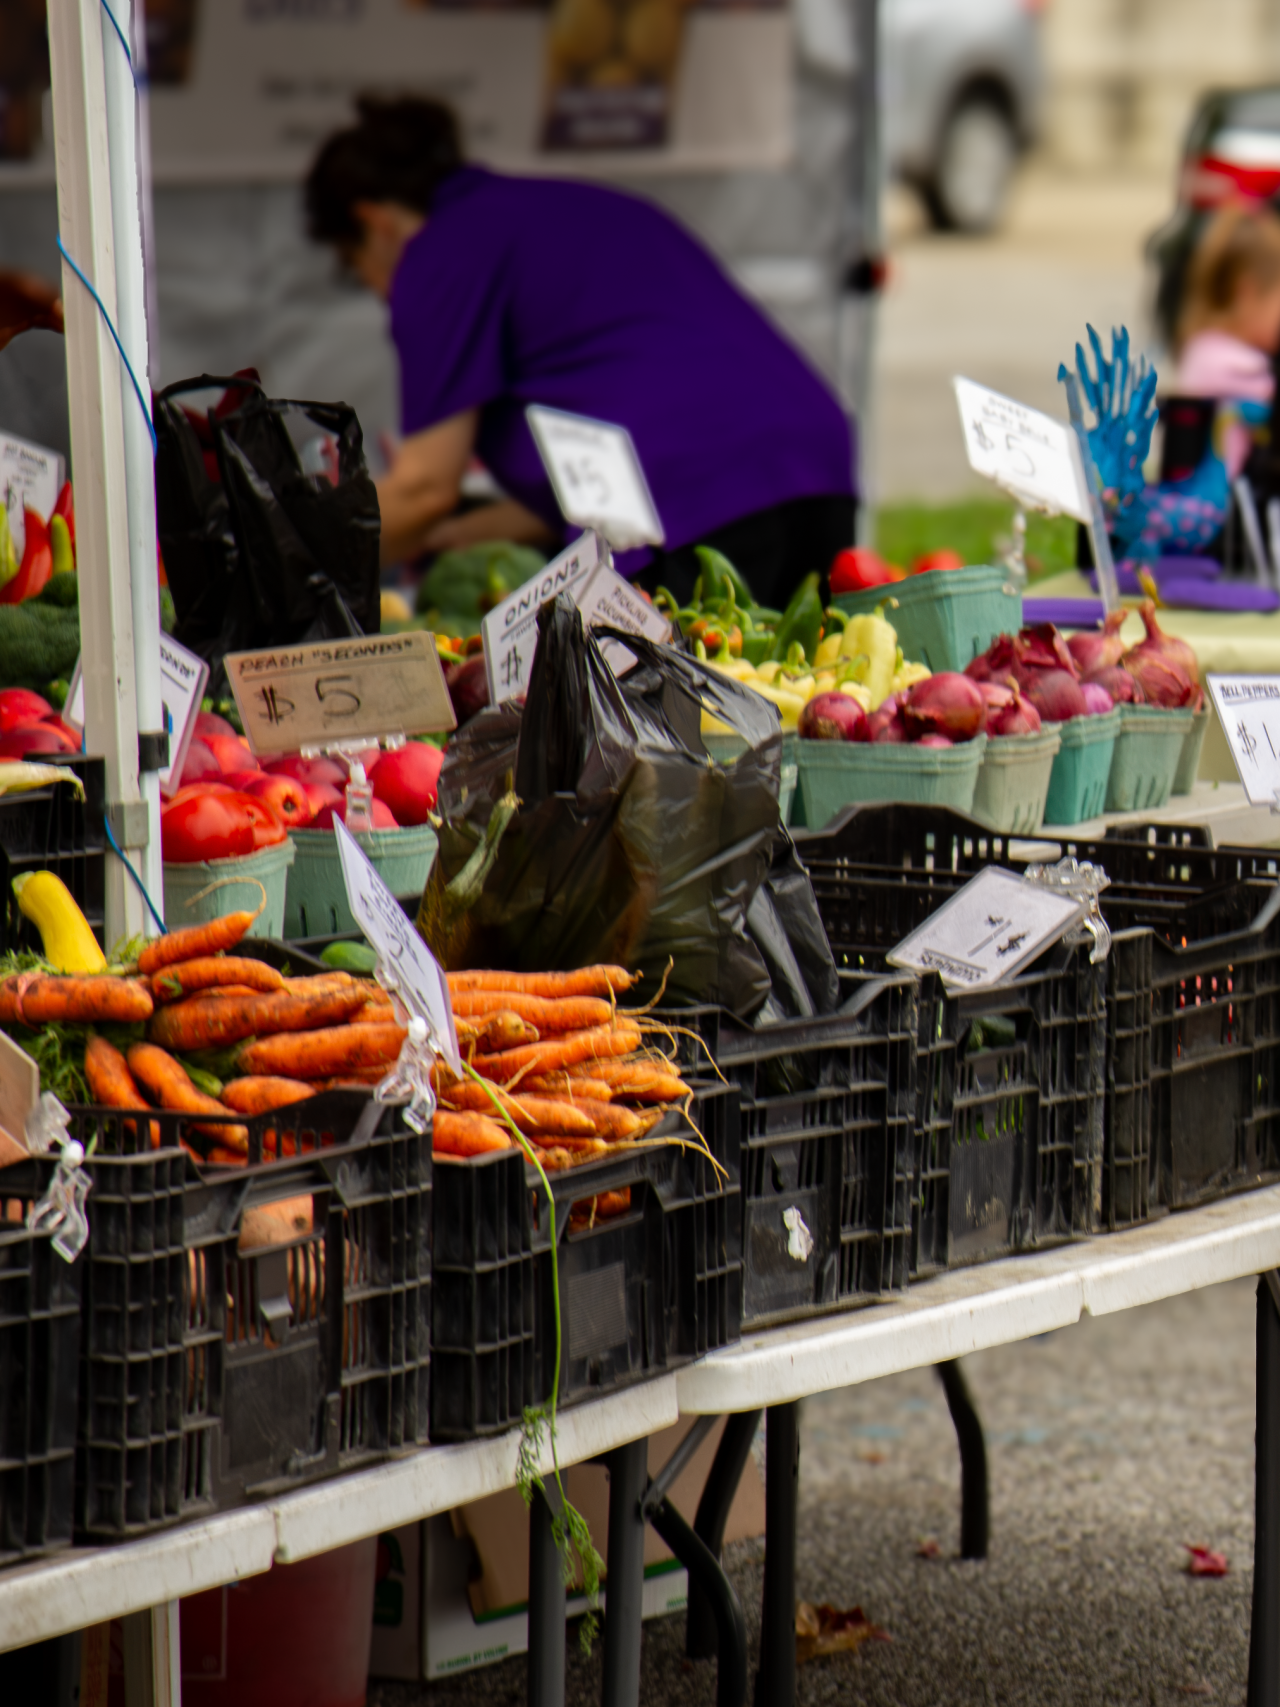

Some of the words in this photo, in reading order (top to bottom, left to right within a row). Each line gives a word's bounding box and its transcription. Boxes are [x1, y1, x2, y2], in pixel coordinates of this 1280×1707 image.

[504, 554, 580, 627] ONIONS
[239, 652, 304, 676] PEACH
[1219, 682, 1243, 699] BELL
[1241, 682, 1280, 700] PEPPERS
